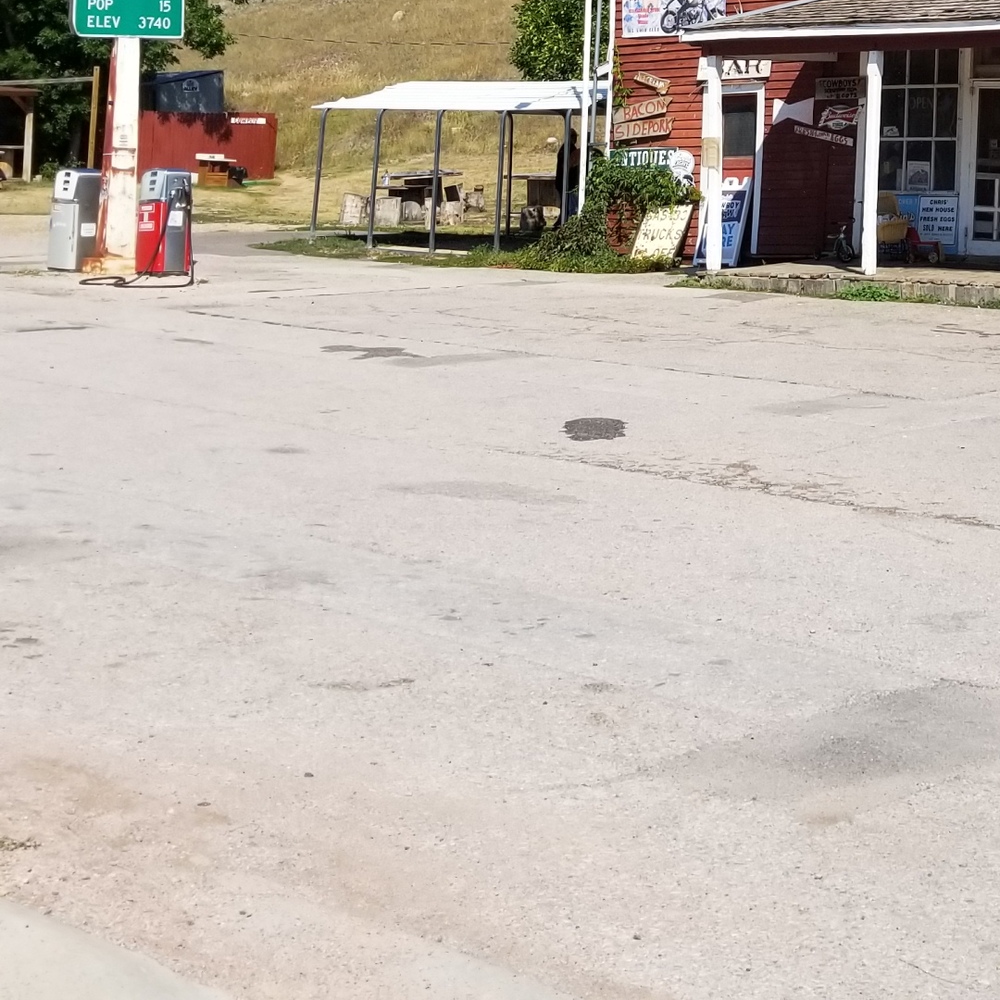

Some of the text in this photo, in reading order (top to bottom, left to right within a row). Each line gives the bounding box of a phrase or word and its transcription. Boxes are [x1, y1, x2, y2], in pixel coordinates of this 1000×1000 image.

[159, 0, 172, 12] 15
[87, 15, 171, 29] ELEV 3740
[623, 99, 667, 120] BACON
[616, 150, 675, 167] NTIQUES
